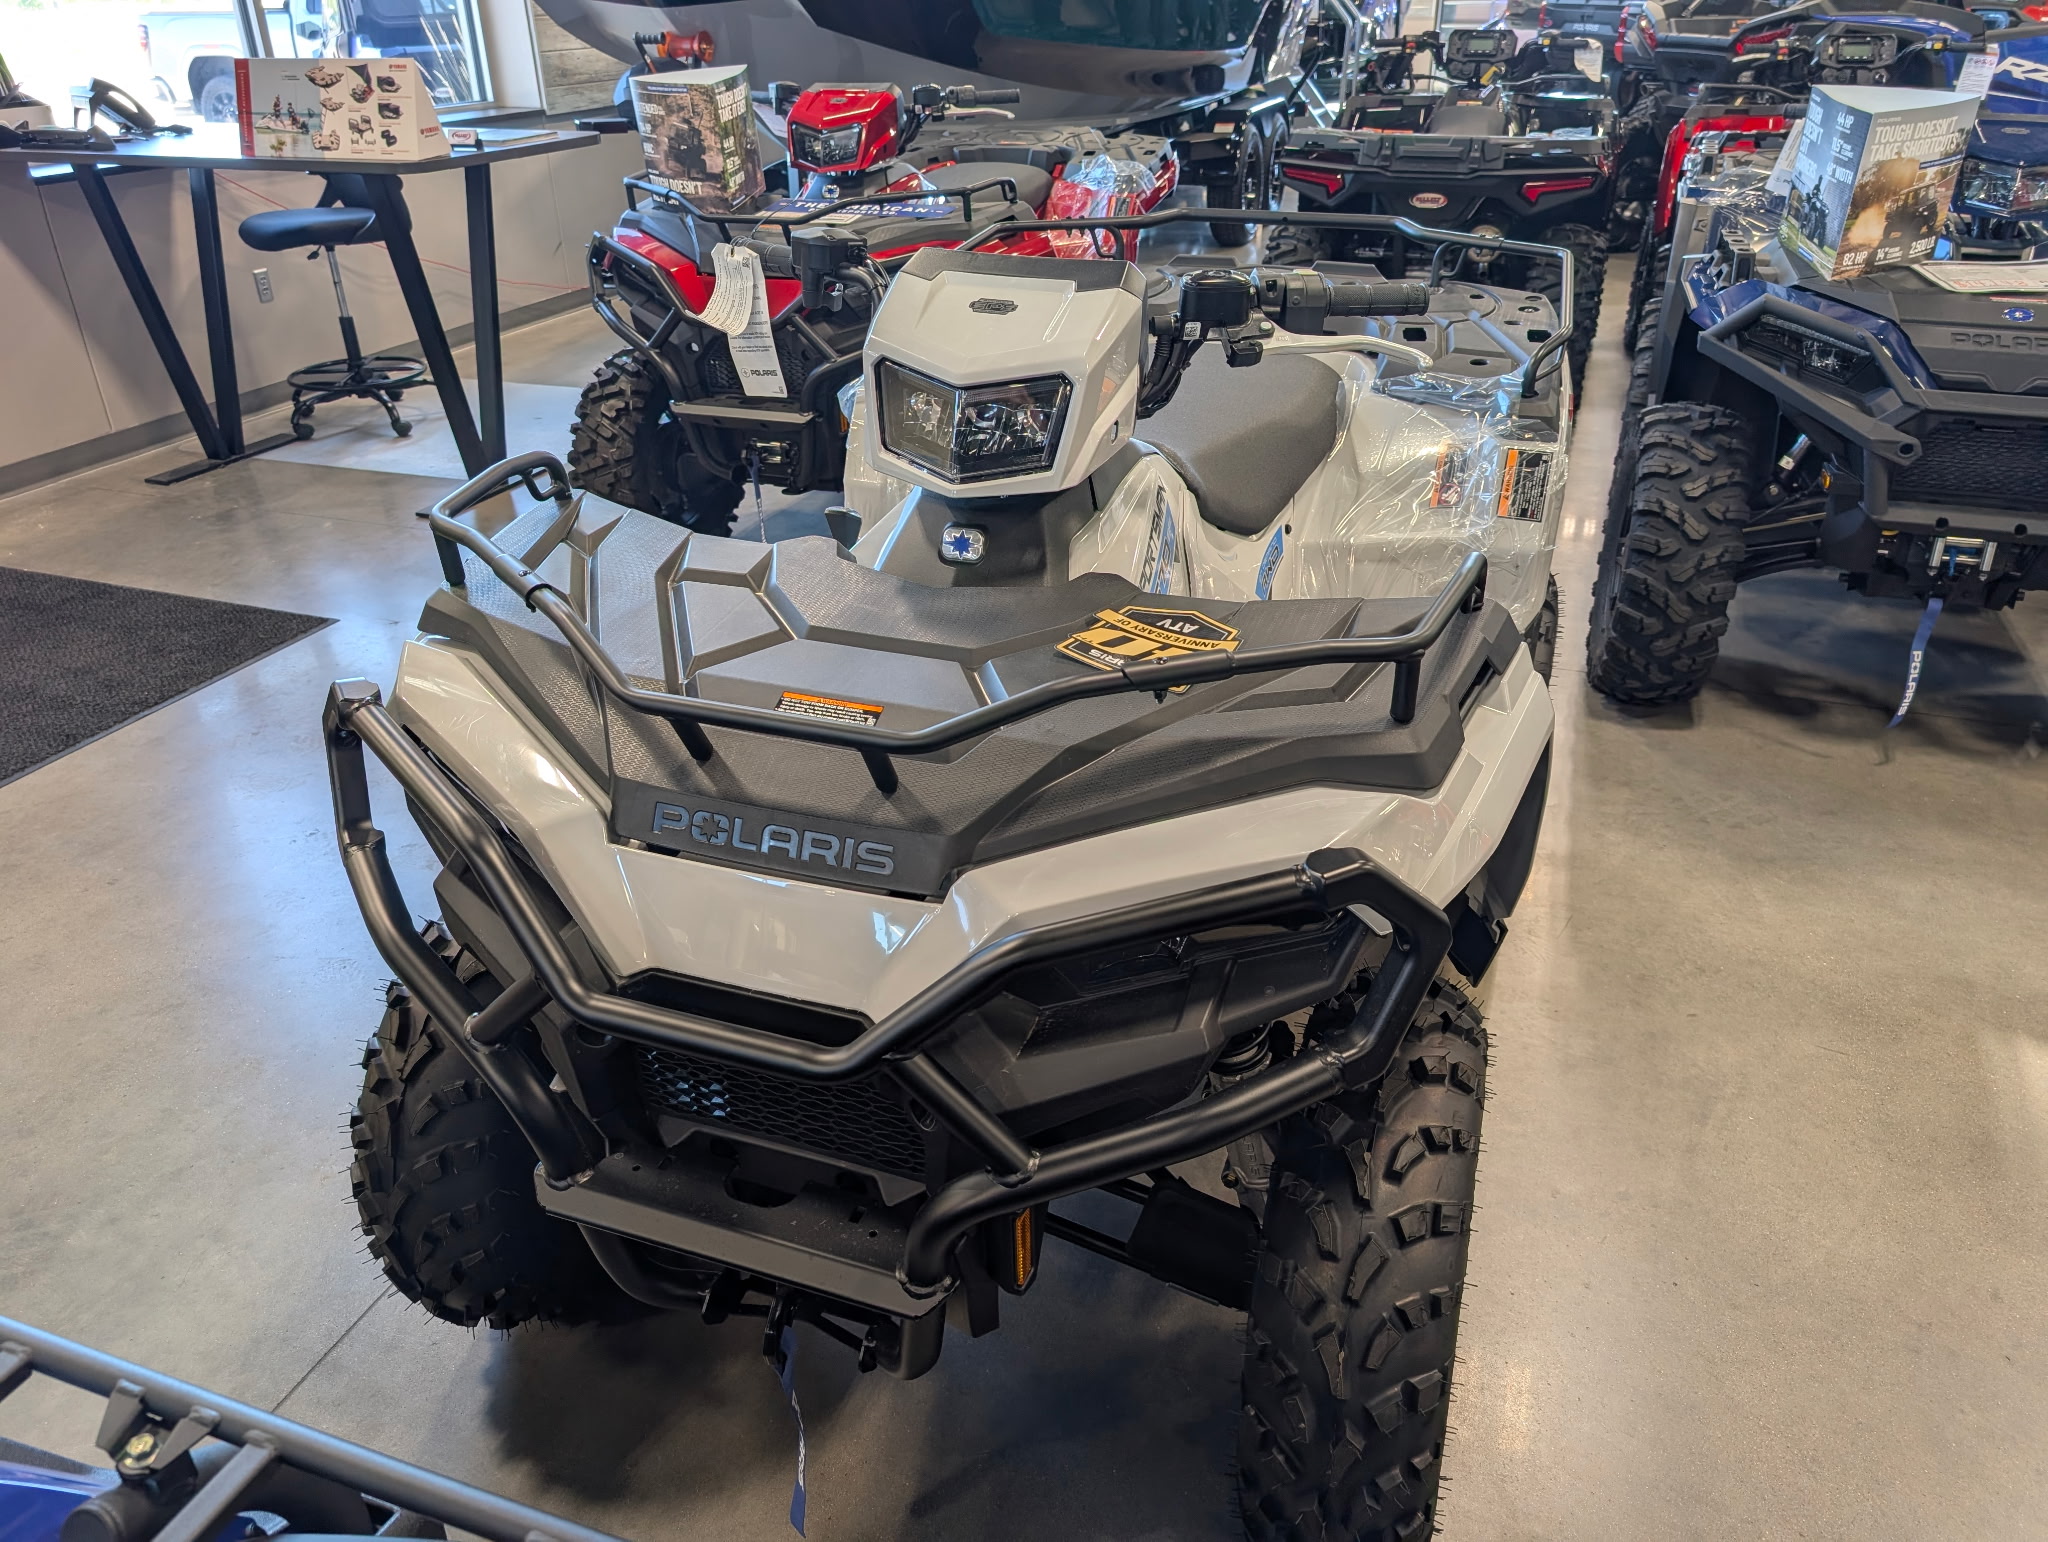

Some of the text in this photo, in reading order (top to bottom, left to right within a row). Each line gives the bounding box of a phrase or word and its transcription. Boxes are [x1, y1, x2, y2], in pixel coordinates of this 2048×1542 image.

[1837, 112, 1854, 129] 44 HP
[1874, 115, 1958, 144] TOUGH DOESN'T
[1870, 142, 1901, 162] TAKE
[1902, 132, 1959, 158] SHORTCUTS
[1834, 166, 1854, 185] WIDTH
[669, 179, 702, 195] DOESN'T
[795, 201, 829, 210] THE
[1843, 253, 1854, 266] 82
[1855, 251, 1868, 264] HP
[750, 369, 778, 377] POLARIS
[1138, 476, 1167, 590] PORTSMAN
[1113, 617, 1222, 650] ANNIVERSARY OF
[1156, 617, 1201, 634] ATV
[1897, 650, 1922, 716] POLARIS
[652, 801, 895, 876] POLARIS
